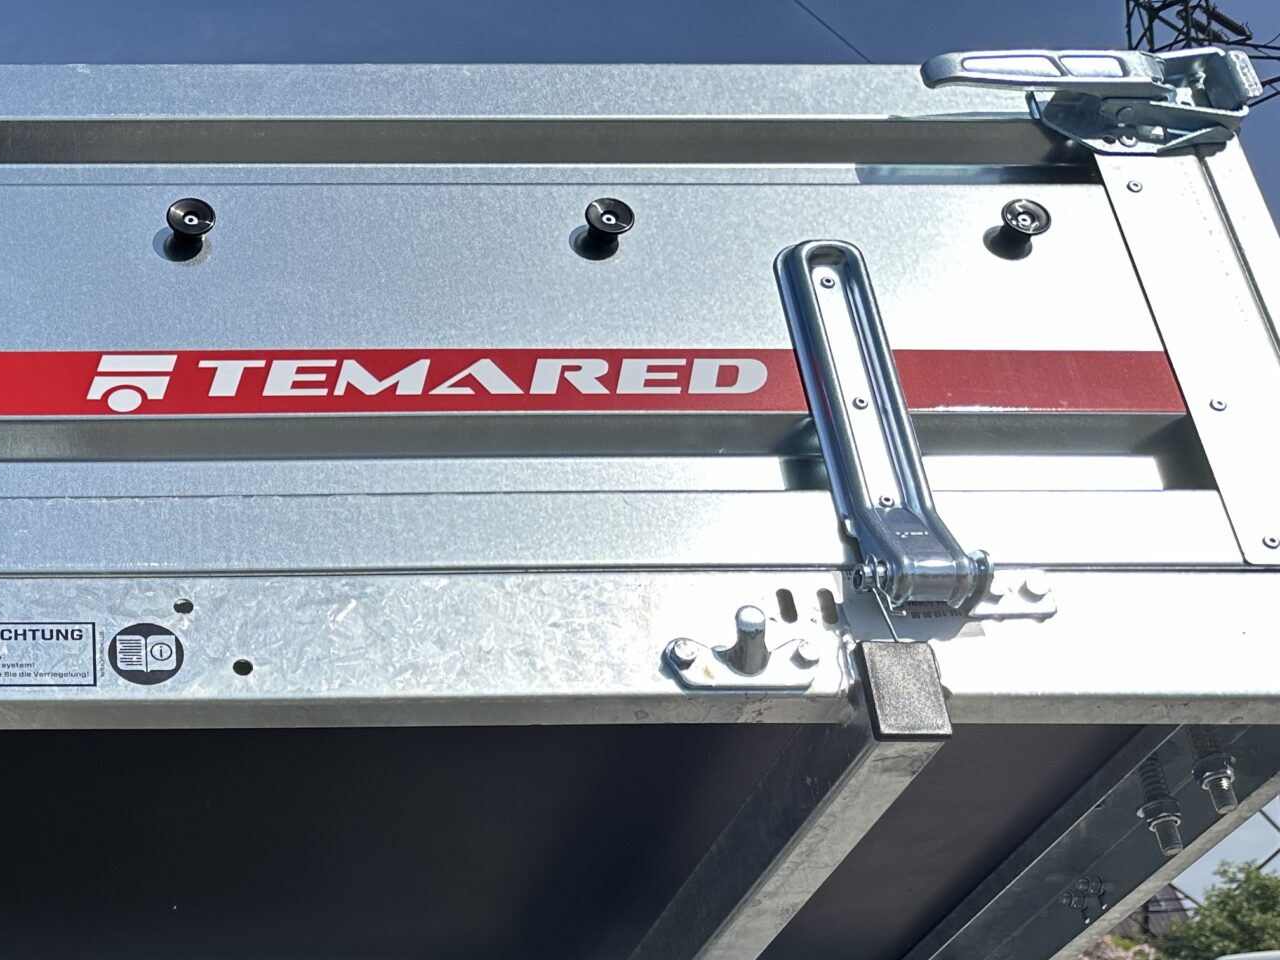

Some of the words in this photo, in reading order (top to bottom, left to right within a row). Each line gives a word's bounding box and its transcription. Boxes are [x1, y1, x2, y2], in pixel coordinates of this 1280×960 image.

[197, 357, 769, 397] TEMARED
[1, 662, 35, 670] system!
[33, 671, 90, 679] Verriegelung!
